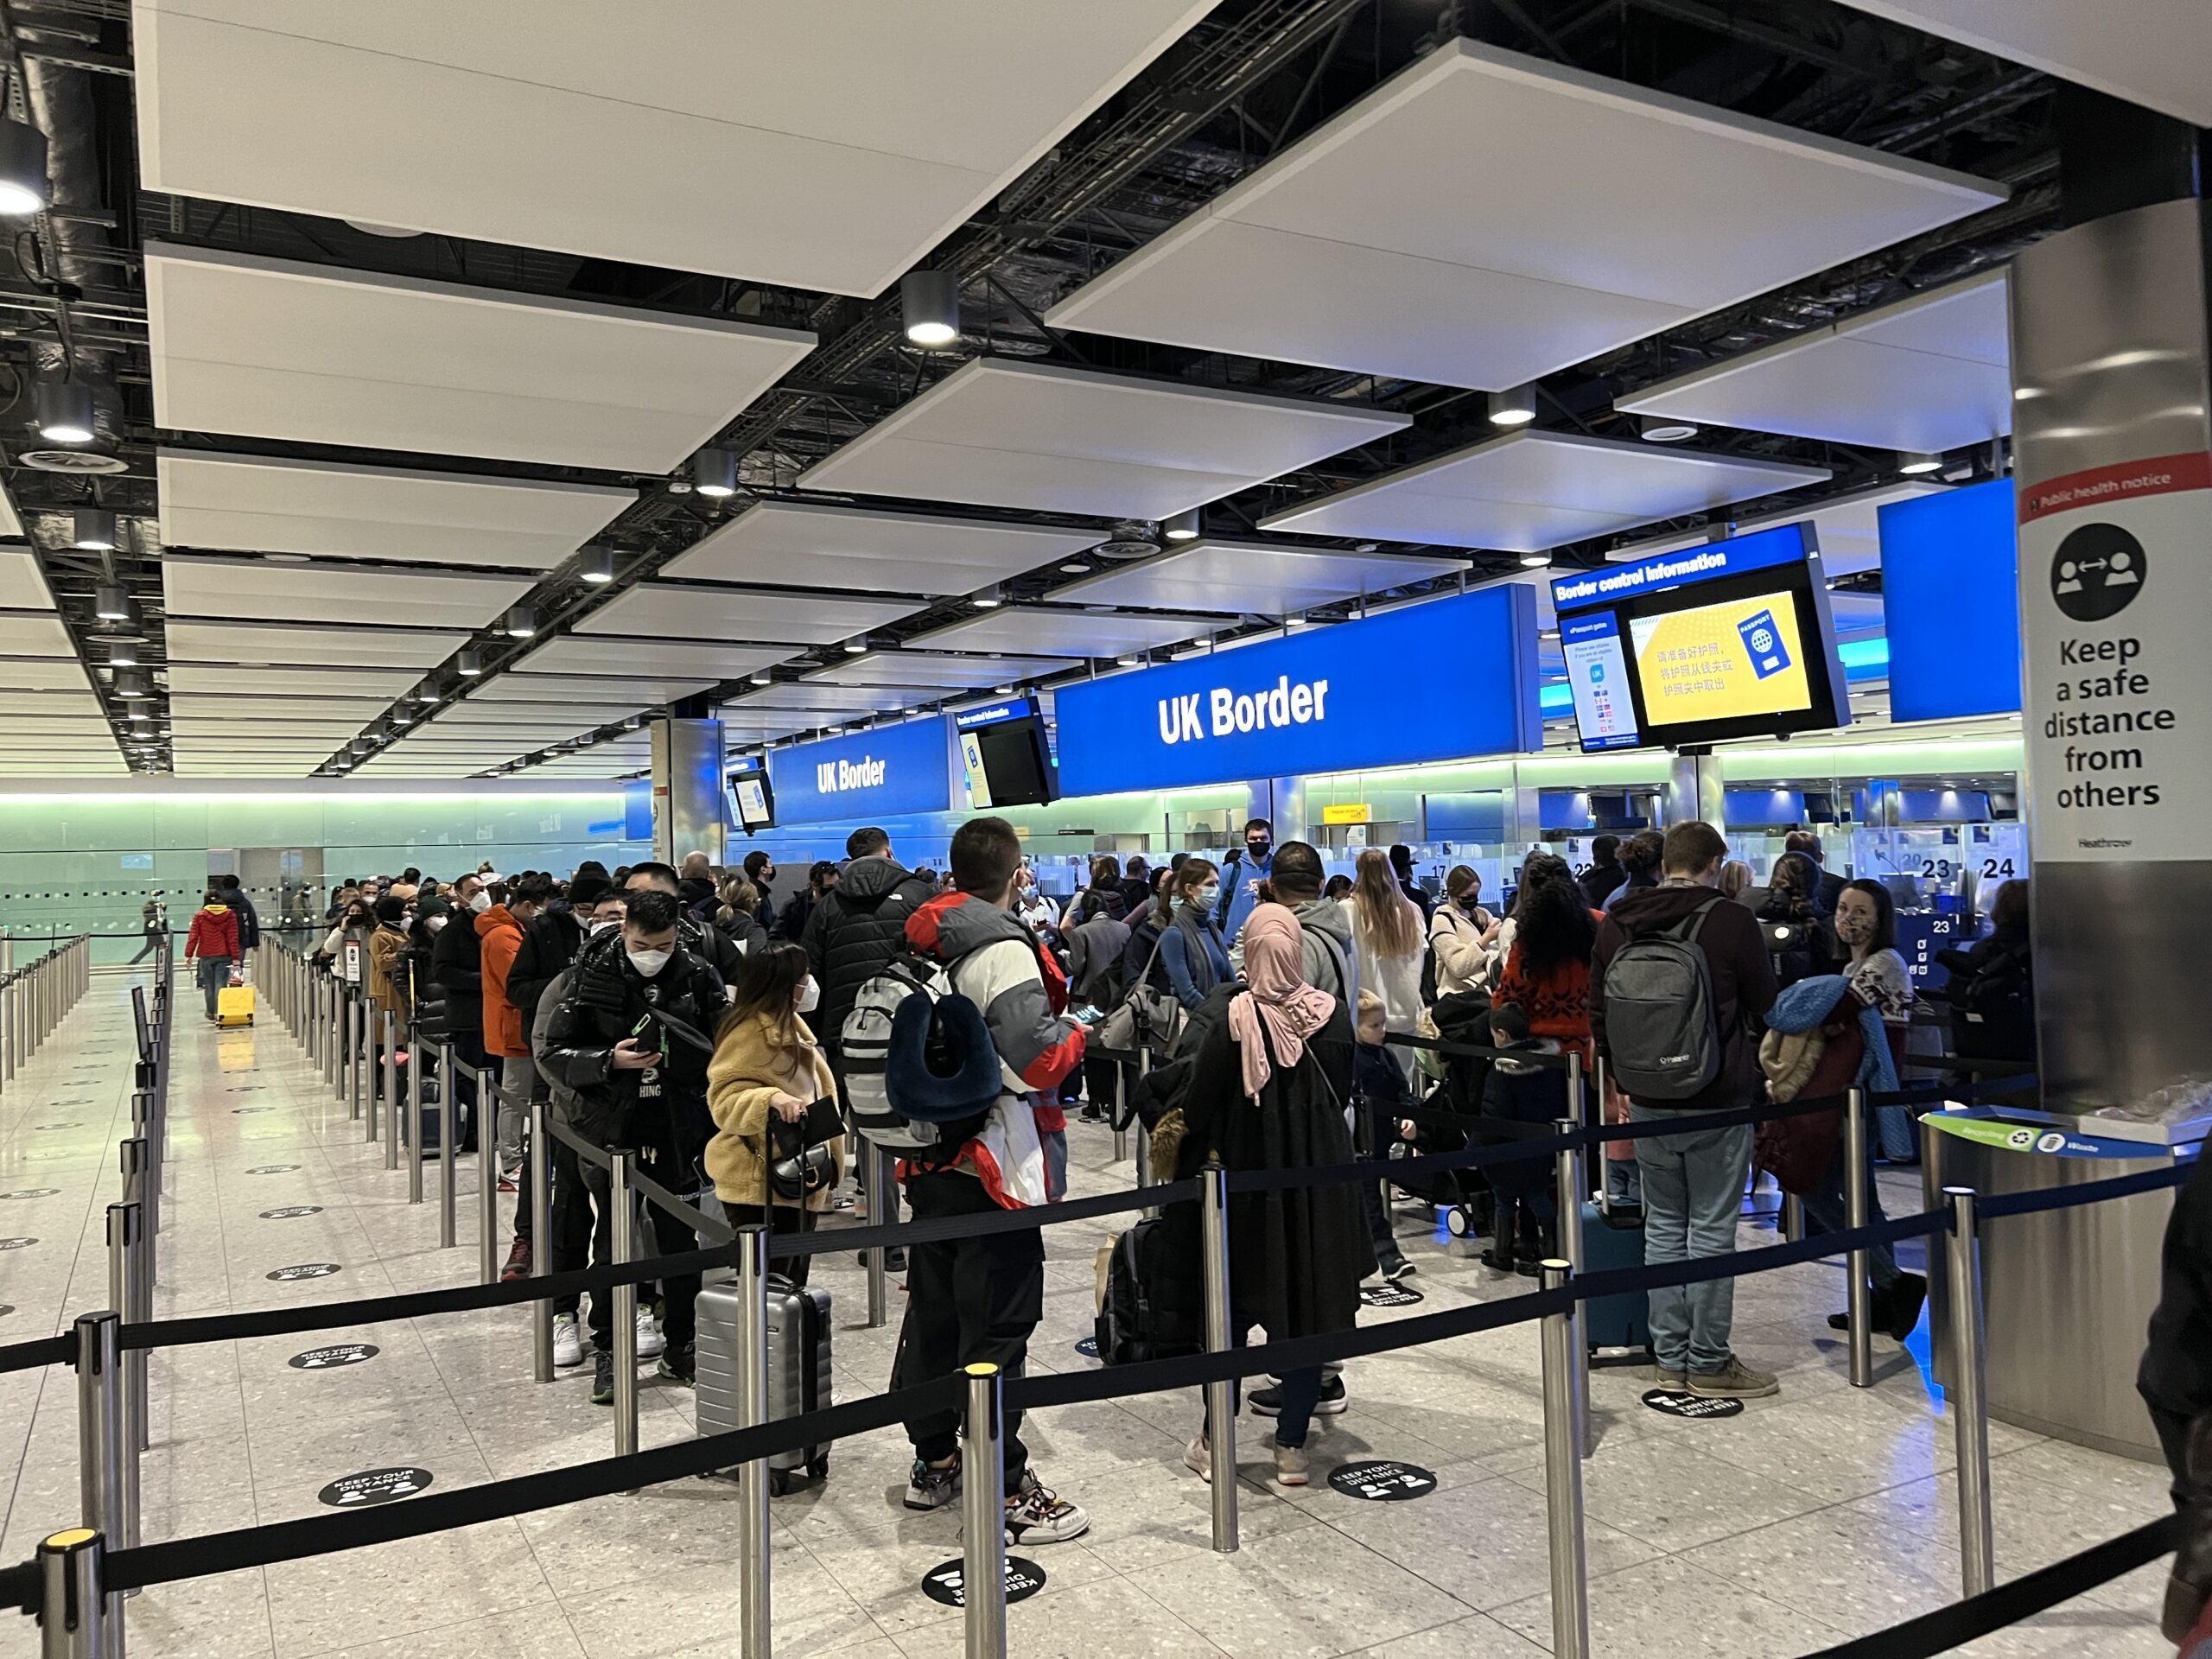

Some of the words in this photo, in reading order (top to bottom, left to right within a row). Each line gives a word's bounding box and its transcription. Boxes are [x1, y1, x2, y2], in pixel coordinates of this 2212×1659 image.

[2040, 490, 2073, 507] Public
[2074, 480, 2120, 499] health
[2121, 474, 2171, 490] notice
[1555, 582, 1597, 601] Border
[1599, 569, 1644, 592] control
[2060, 638, 2140, 666] Keep
[2056, 682, 2070, 702] a
[2079, 668, 2150, 699] safe
[1159, 693, 1204, 744] UK
[1211, 676, 1328, 736] Border
[2044, 709, 2176, 739] distance
[2064, 746, 2143, 772] from
[817, 762, 836, 793] UK
[839, 755, 885, 791] Border
[2057, 781, 2160, 809] others
[2078, 838, 2133, 849] Heathrow
[1432, 865, 1446, 879] 17
[1922, 859, 1950, 879] 23
[1983, 858, 2015, 879] 24
[1933, 921, 1949, 933] 23
[334, 1478, 370, 1488] KEEP
[372, 1470, 414, 1481] YOUR
[340, 1475, 410, 1491] DISTANCE
[1333, 1471, 1362, 1482] KEEP
[1346, 1469, 1404, 1485] DISTANCE
